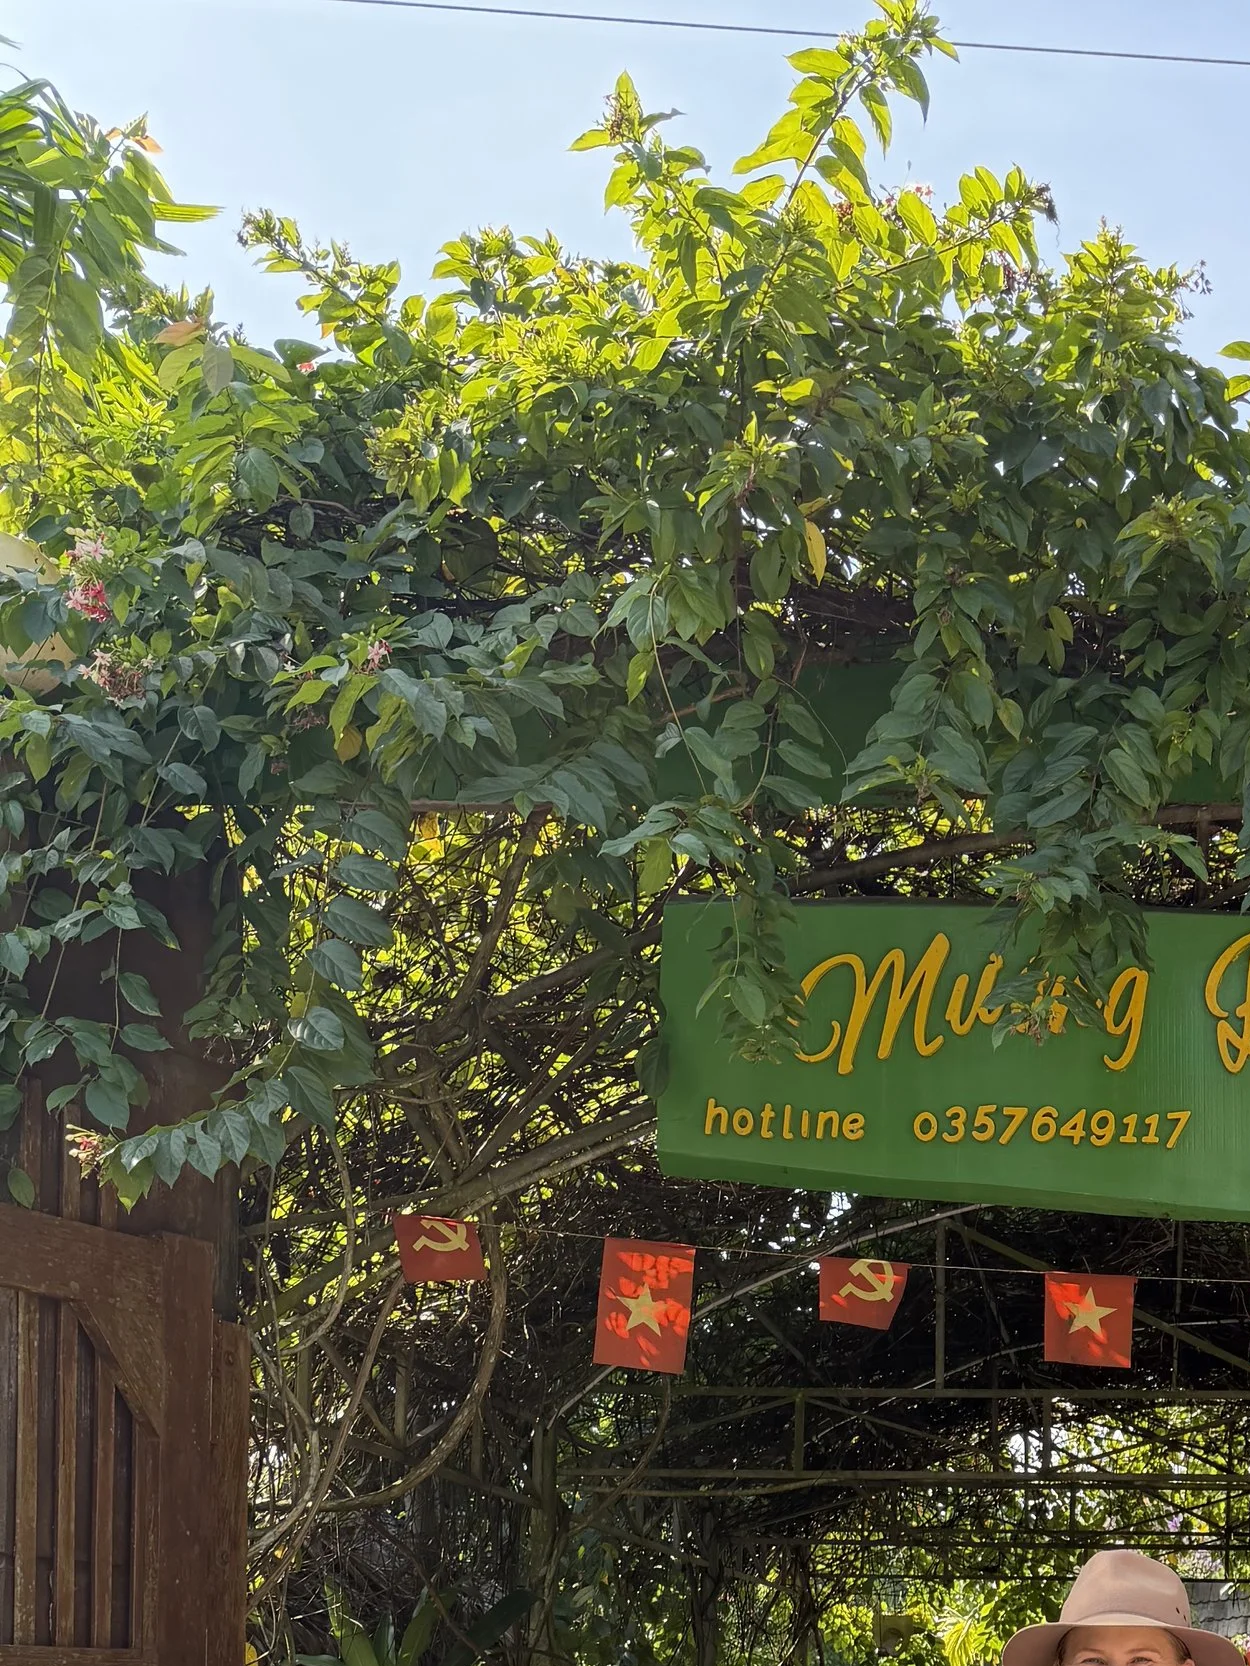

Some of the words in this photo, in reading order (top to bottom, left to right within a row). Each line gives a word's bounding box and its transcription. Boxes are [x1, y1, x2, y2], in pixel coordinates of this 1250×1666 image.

[787, 932, 1149, 1076] Mưg
[703, 1097, 866, 1142] hotline
[912, 1104, 1192, 1150] 0357649117
